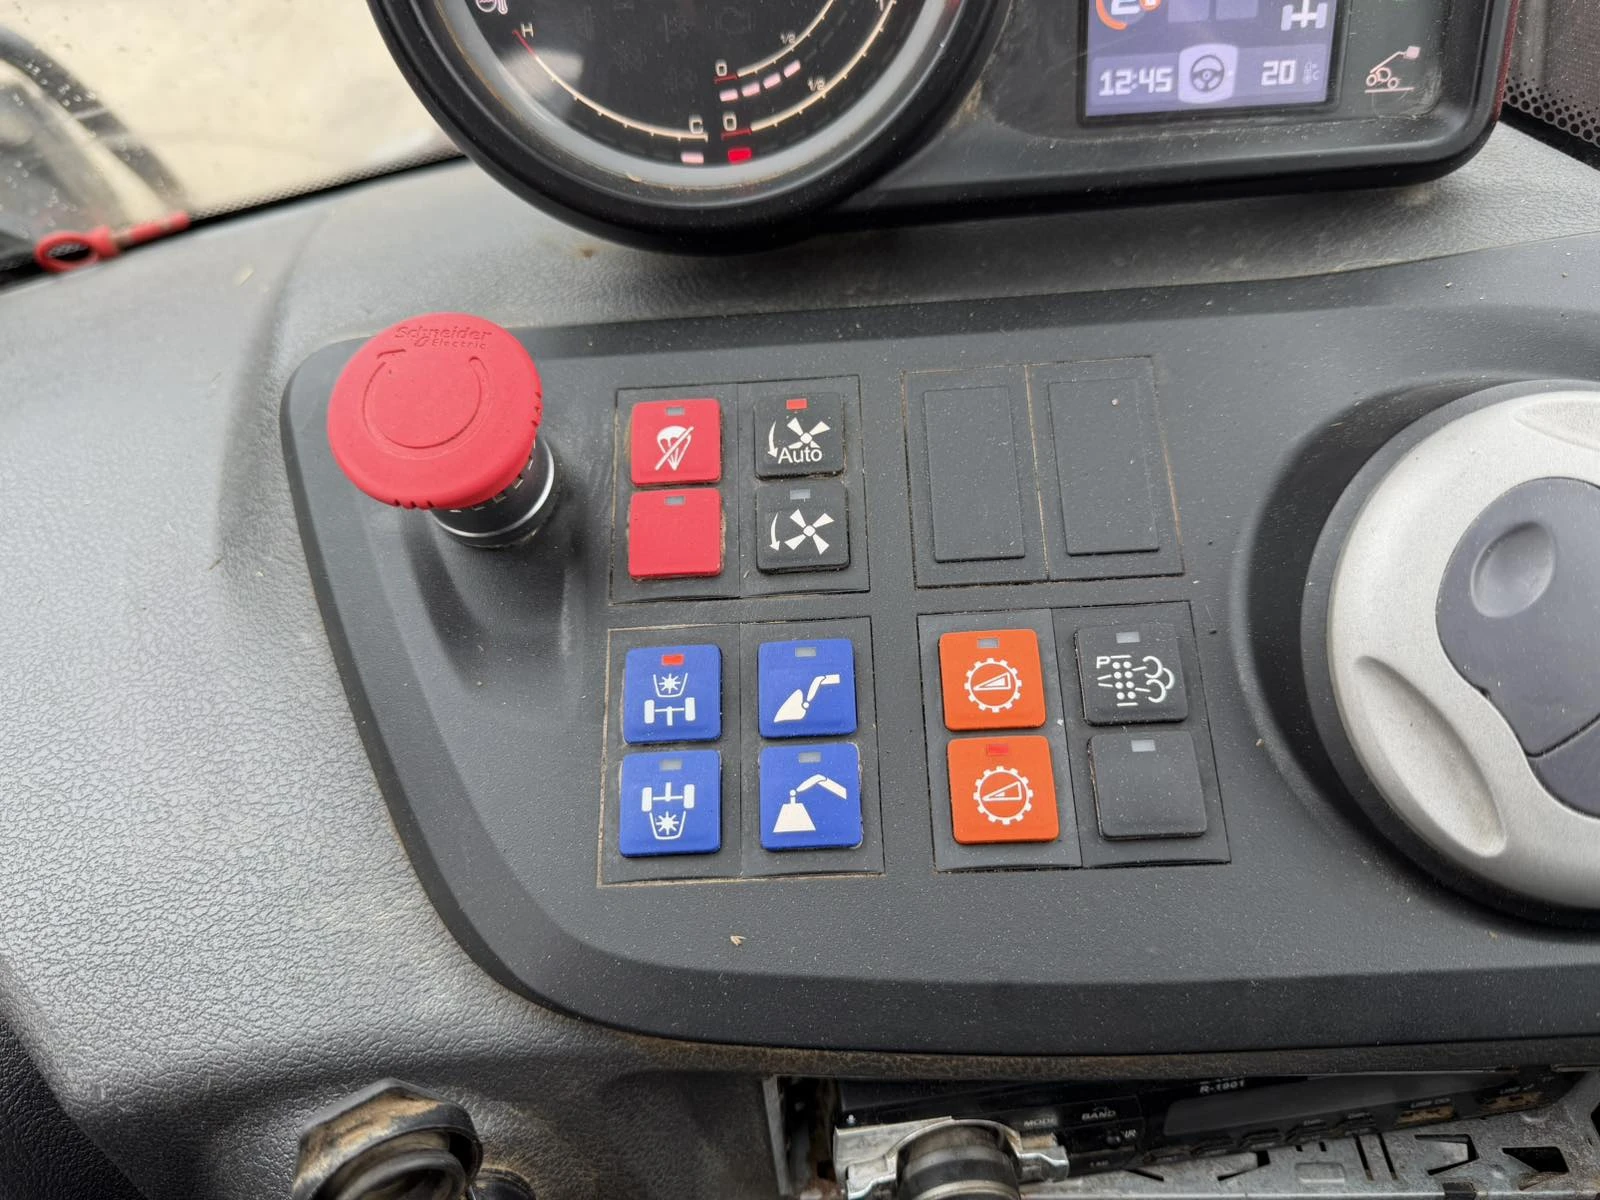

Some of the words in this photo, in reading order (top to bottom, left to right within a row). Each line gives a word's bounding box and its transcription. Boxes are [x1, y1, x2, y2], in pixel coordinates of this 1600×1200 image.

[520, 22, 534, 38] H
[1261, 60, 1297, 86] 20
[1099, 67, 1174, 97] 12:45
[394, 325, 493, 341] Schneider
[431, 338, 487, 350] Electric
[777, 446, 823, 465] Auto
[1023, 1116, 1058, 1128] MODE
[1081, 1108, 1117, 1121] BAND
